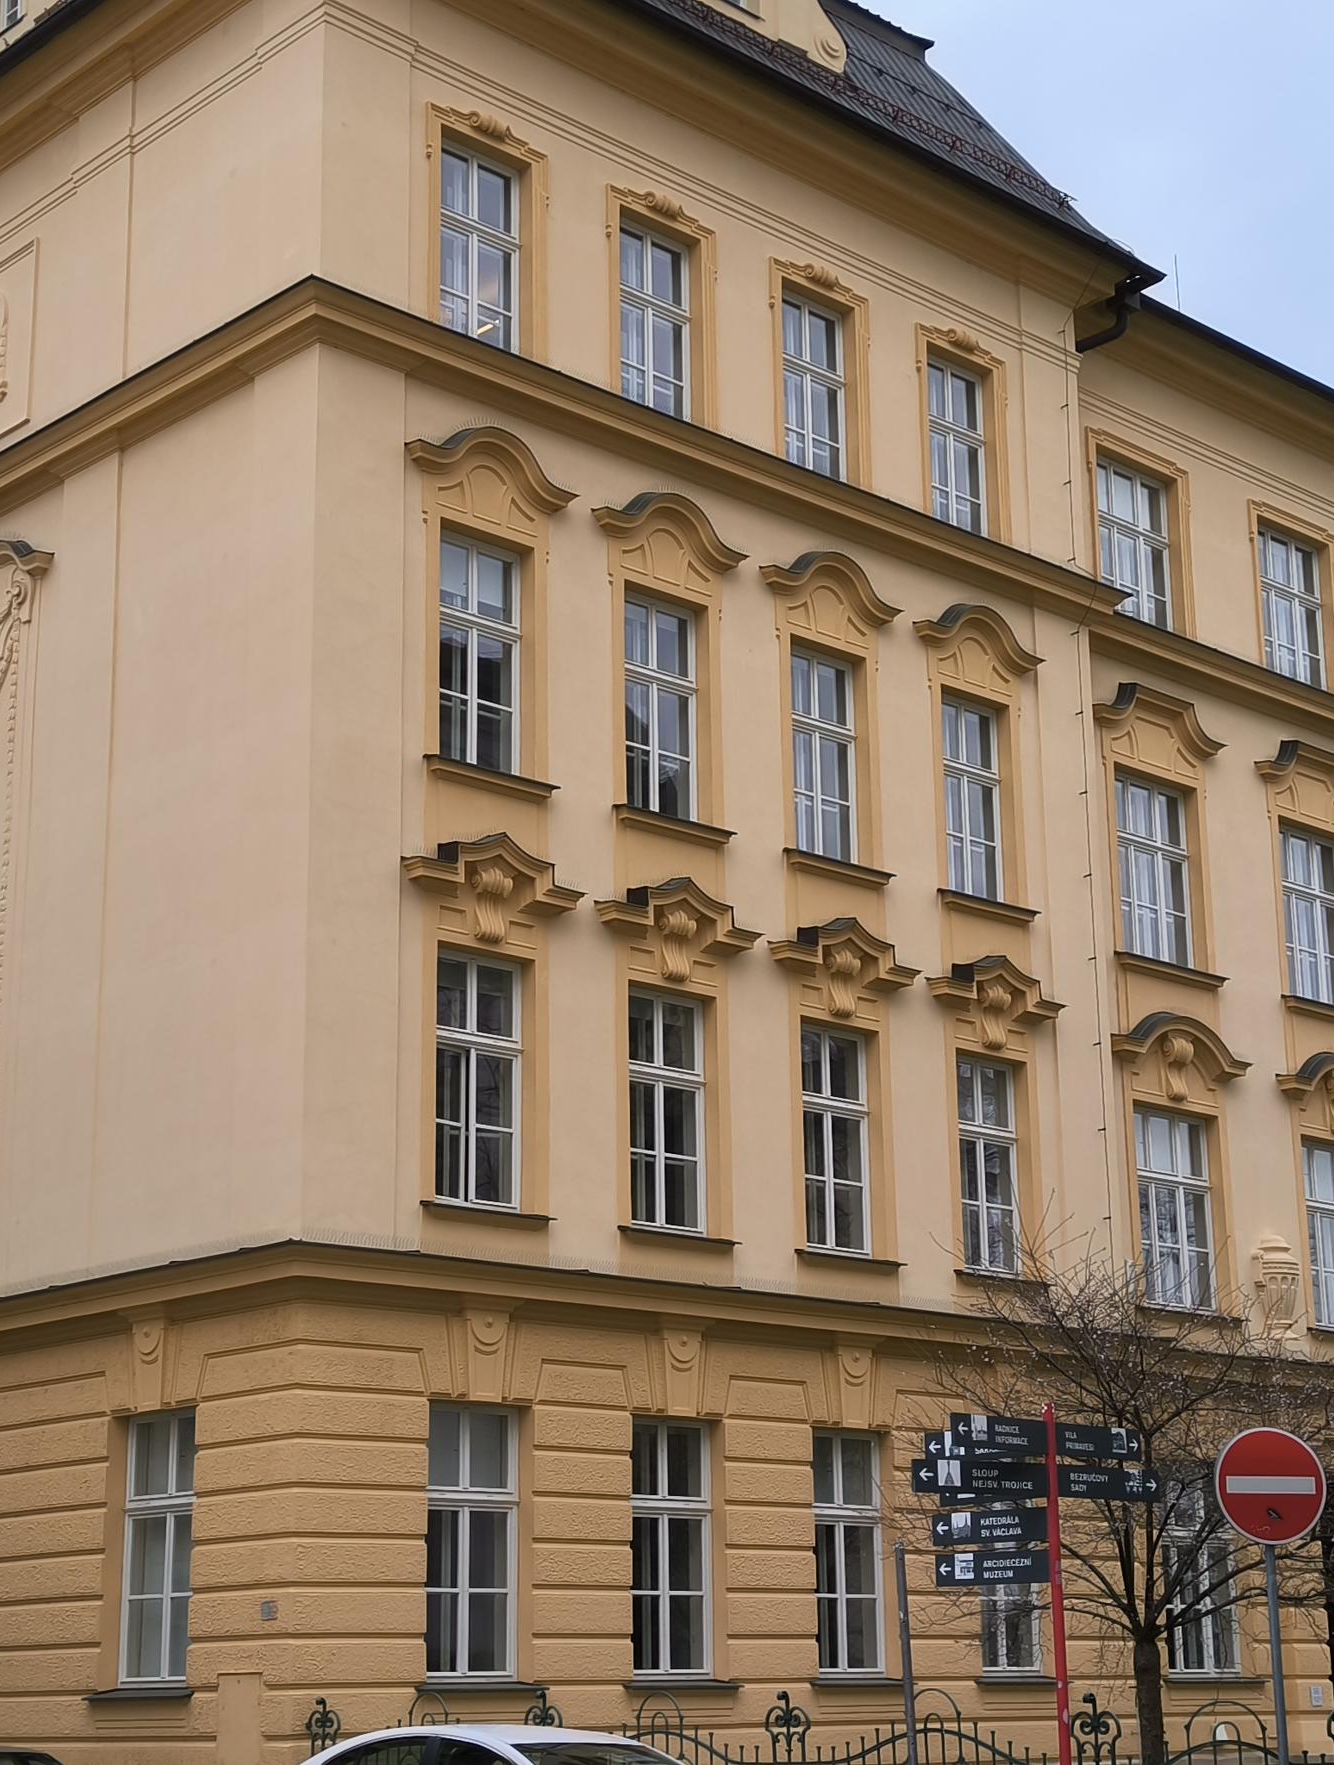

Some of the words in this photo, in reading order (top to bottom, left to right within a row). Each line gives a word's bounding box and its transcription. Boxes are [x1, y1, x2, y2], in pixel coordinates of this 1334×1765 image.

[972, 1469, 999, 1477] SLOUP
[1001, 1481, 1033, 1490] TROJICE
[1070, 1483, 1087, 1492] SADY
[980, 1515, 1019, 1526] KATEDRÁLA
[980, 1529, 991, 1537] SV.
[992, 1526, 1022, 1536] VÁCLAVA
[983, 1556, 1032, 1568] ARCIDIECEZNÍ
[983, 1570, 1013, 1579] MUZEUM
